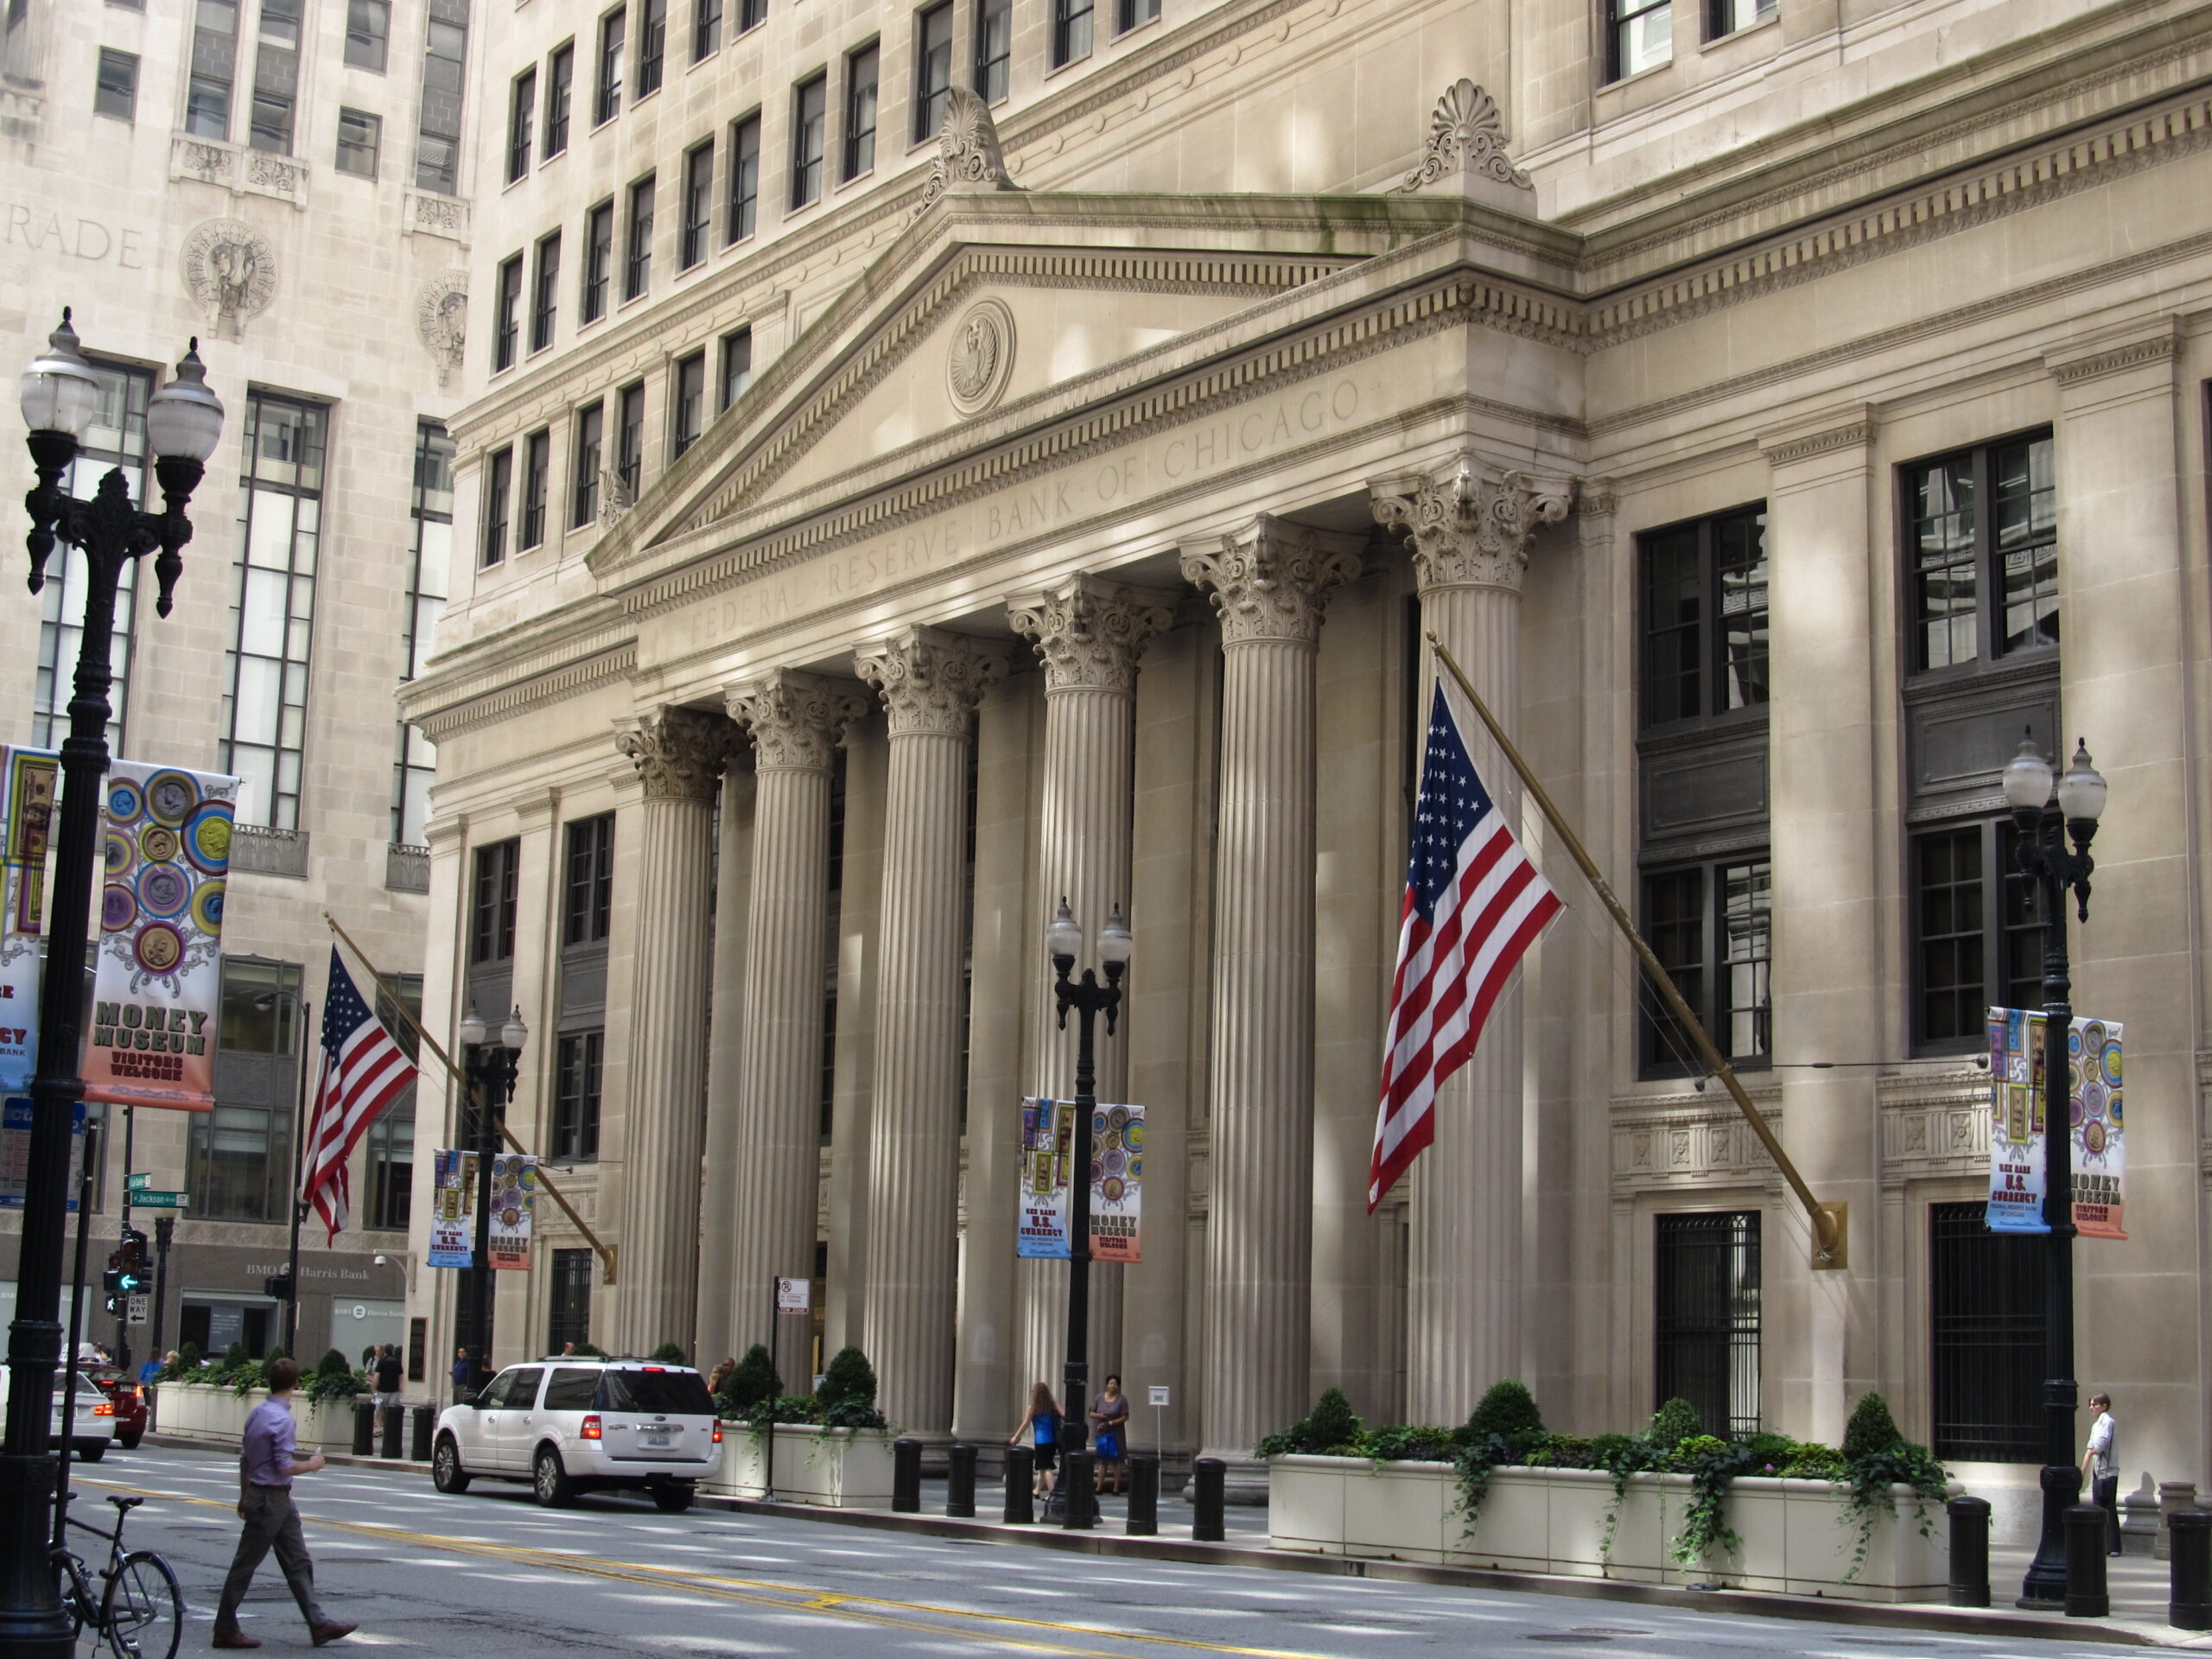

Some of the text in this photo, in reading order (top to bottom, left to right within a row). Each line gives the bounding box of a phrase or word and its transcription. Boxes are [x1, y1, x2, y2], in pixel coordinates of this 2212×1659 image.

[5, 204, 143, 270] RADE
[691, 380, 1358, 645] FEDERAL RESERVE BANK OF CHICAGO
[95, 1001, 207, 1035] MONEY
[93, 1026, 206, 1056] MUSEUM
[111, 1051, 183, 1069] VISITORS
[111, 1064, 183, 1081] WELCOME
[1999, 1163, 2031, 1174] SEE RARE
[2005, 1174, 2025, 1191] U.S.
[138, 1194, 164, 1203] Jackson
[1992, 1191, 2037, 1204] CURRENCY
[2075, 1205, 2108, 1214] VISITORS
[1032, 1216, 1052, 1228] U.S.
[1090, 1215, 1136, 1227] MONEY
[2075, 1213, 2107, 1222] WELCOME
[1020, 1227, 1062, 1236] CURRENCY
[1090, 1226, 1136, 1236] MUSEUM
[442, 1236, 459, 1245] U.S.
[490, 1236, 528, 1245] MONEY
[246, 1265, 370, 1280] BMO Harris Bank
